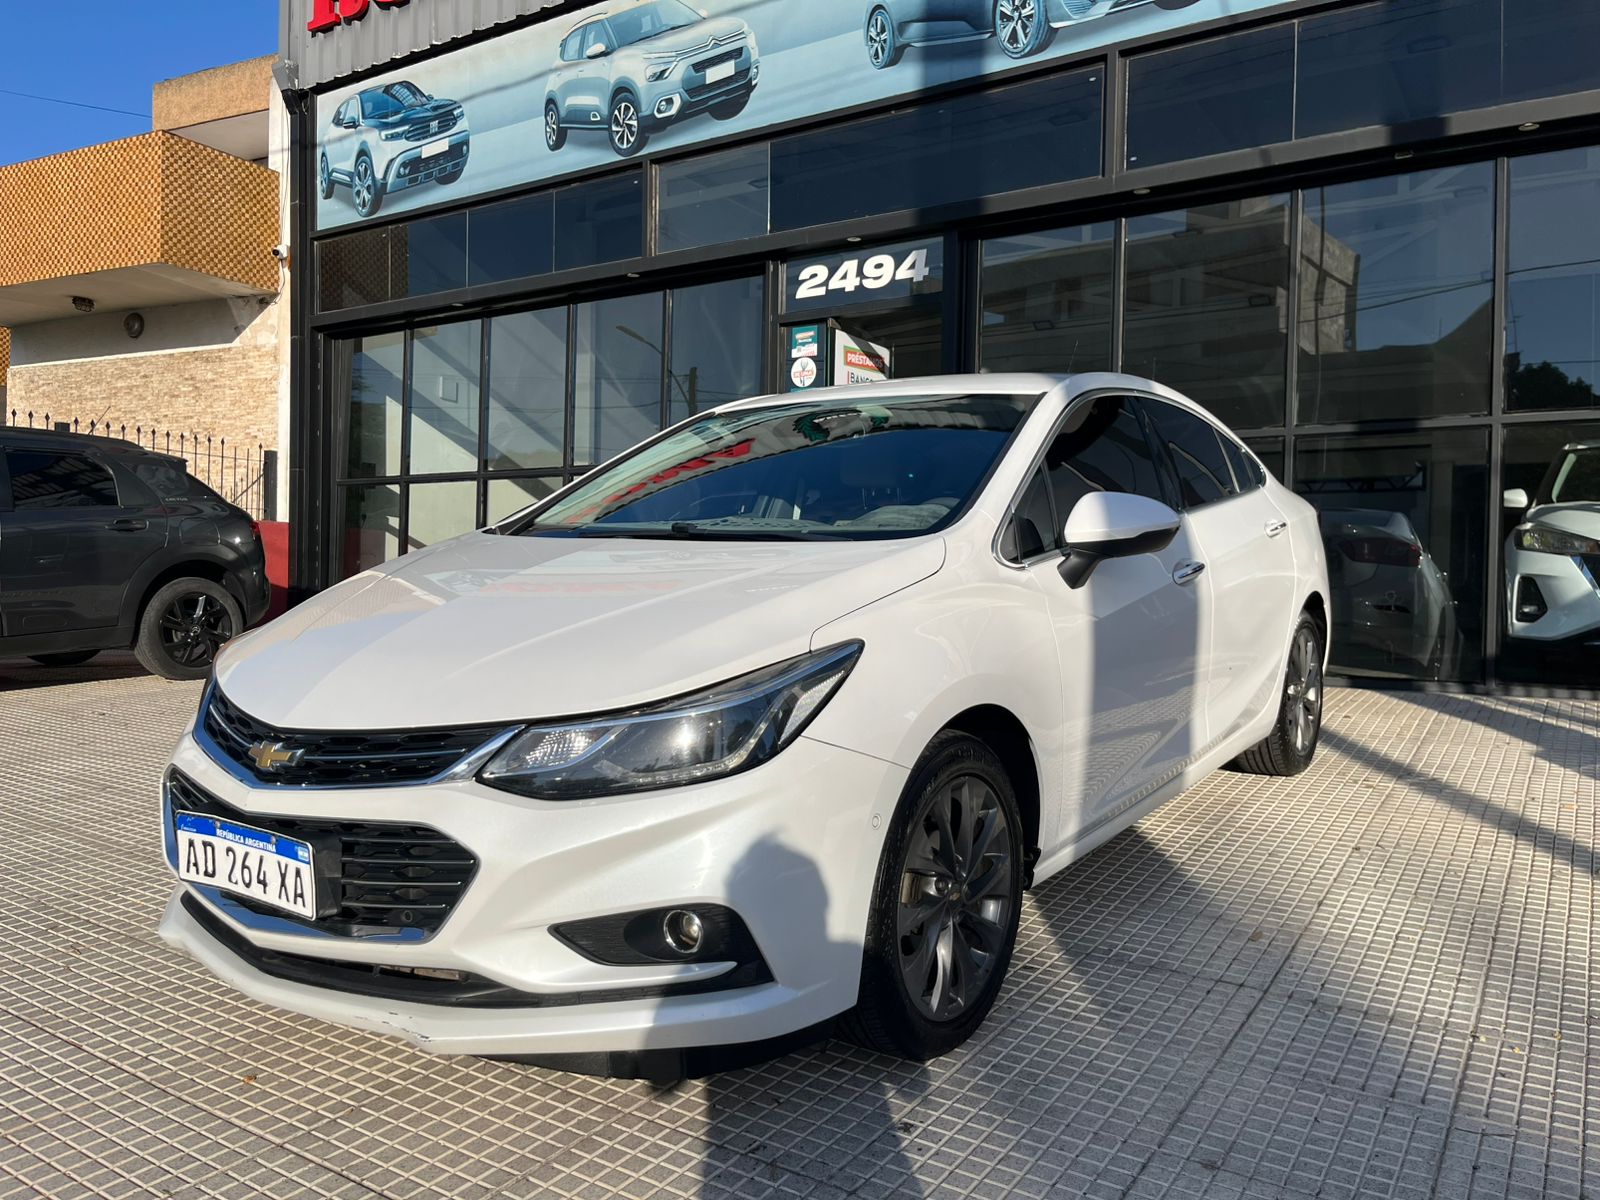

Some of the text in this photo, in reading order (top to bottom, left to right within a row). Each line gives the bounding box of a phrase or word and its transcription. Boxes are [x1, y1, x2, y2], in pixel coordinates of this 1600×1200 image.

[795, 249, 930, 299] 2494
[216, 828, 244, 844] REPÚBLICA
[245, 837, 276, 853] ARGENTINA
[186, 838, 306, 908] AD 264 XA
